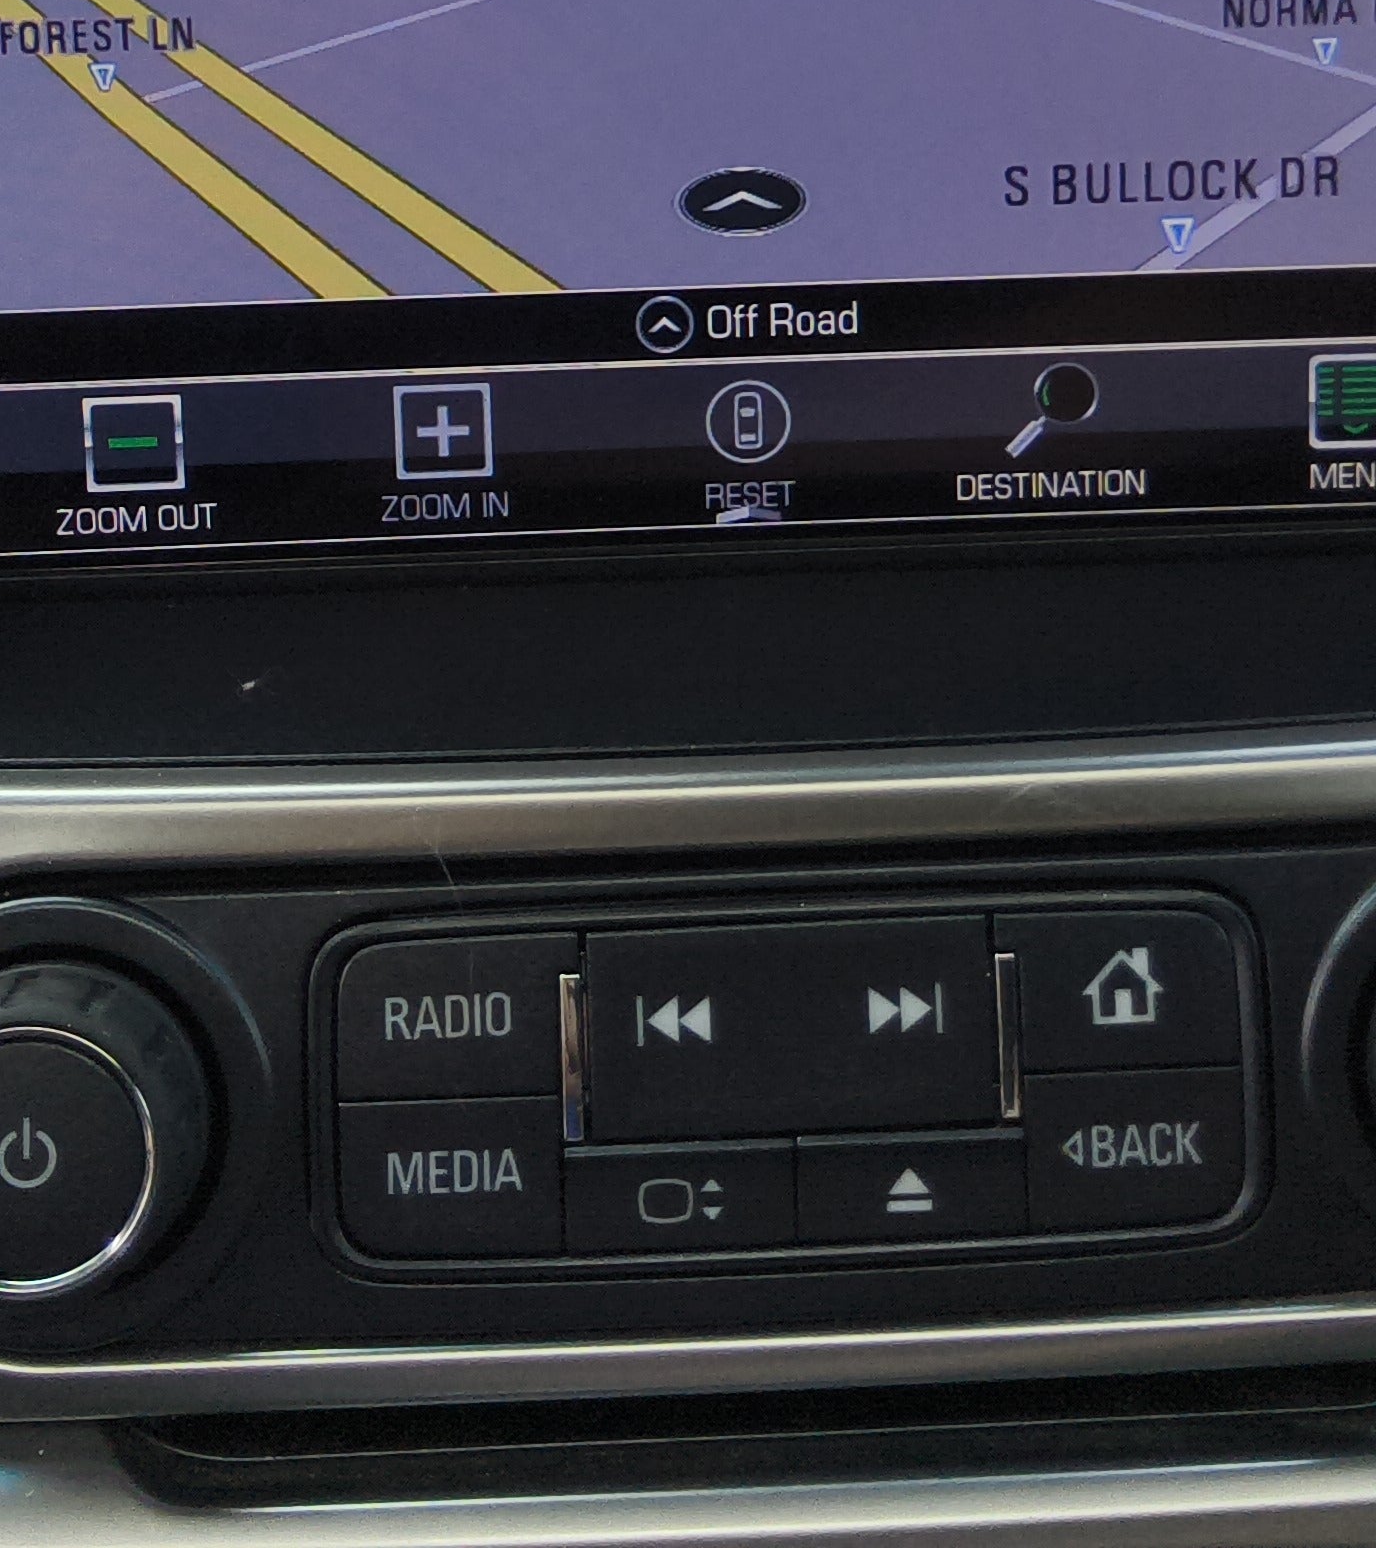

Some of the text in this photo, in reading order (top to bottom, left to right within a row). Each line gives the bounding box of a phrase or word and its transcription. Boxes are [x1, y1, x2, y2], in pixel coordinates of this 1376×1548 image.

[0, 18, 194, 54] FOREST LN
[1004, 155, 1340, 207] S BULLOCK DR
[707, 300, 858, 339] Off Road
[705, 480, 796, 509] RESET
[956, 468, 1145, 501] DESTINATION
[56, 502, 218, 536] ZOOM OUT
[381, 491, 509, 522] ZOOM IN
[384, 991, 512, 1041] RADIO
[1091, 1122, 1203, 1168] BACK
[386, 1148, 523, 1195] MEDIA
